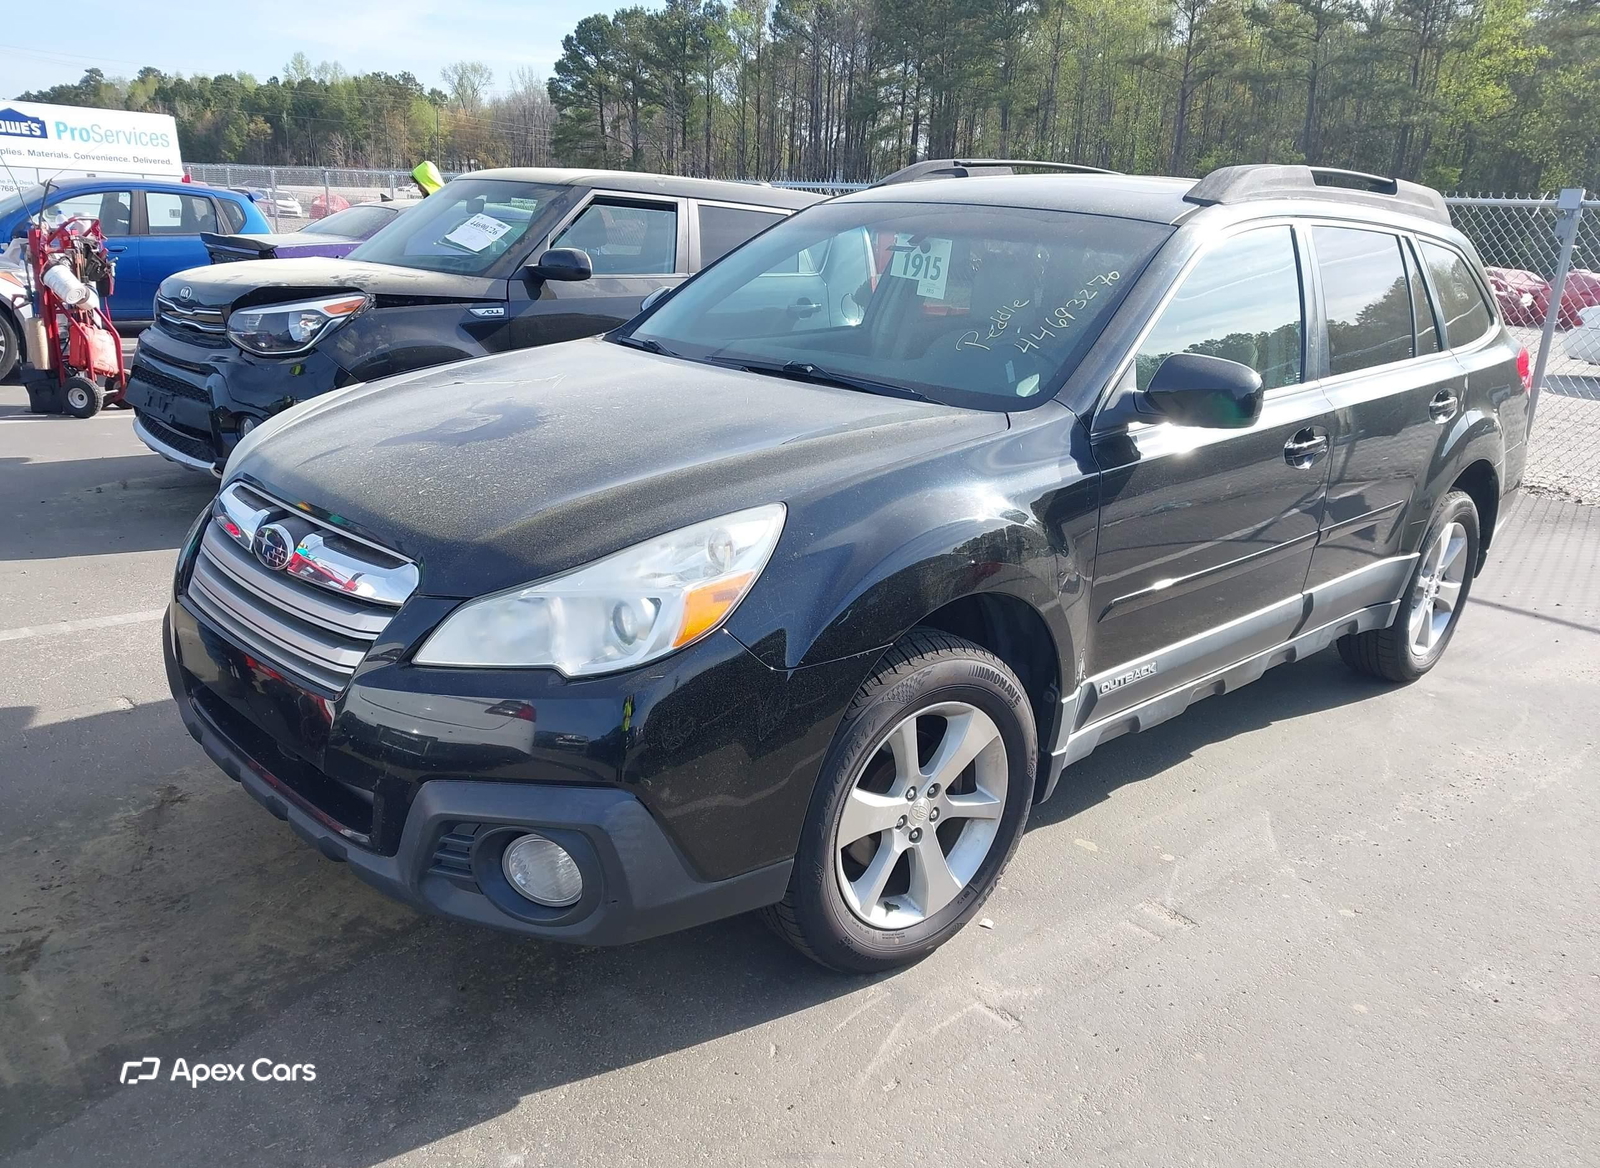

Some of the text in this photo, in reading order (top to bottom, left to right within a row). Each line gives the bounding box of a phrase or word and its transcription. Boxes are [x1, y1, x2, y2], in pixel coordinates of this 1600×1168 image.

[55, 121, 170, 148] ProServices
[27, 149, 71, 160] Materials.
[74, 152, 131, 163] Convenience.
[132, 156, 173, 166] Delivered.
[902, 252, 942, 281] 1915
[1014, 269, 1121, 354] 44693270
[1100, 661, 1158, 695] OUTBACK
